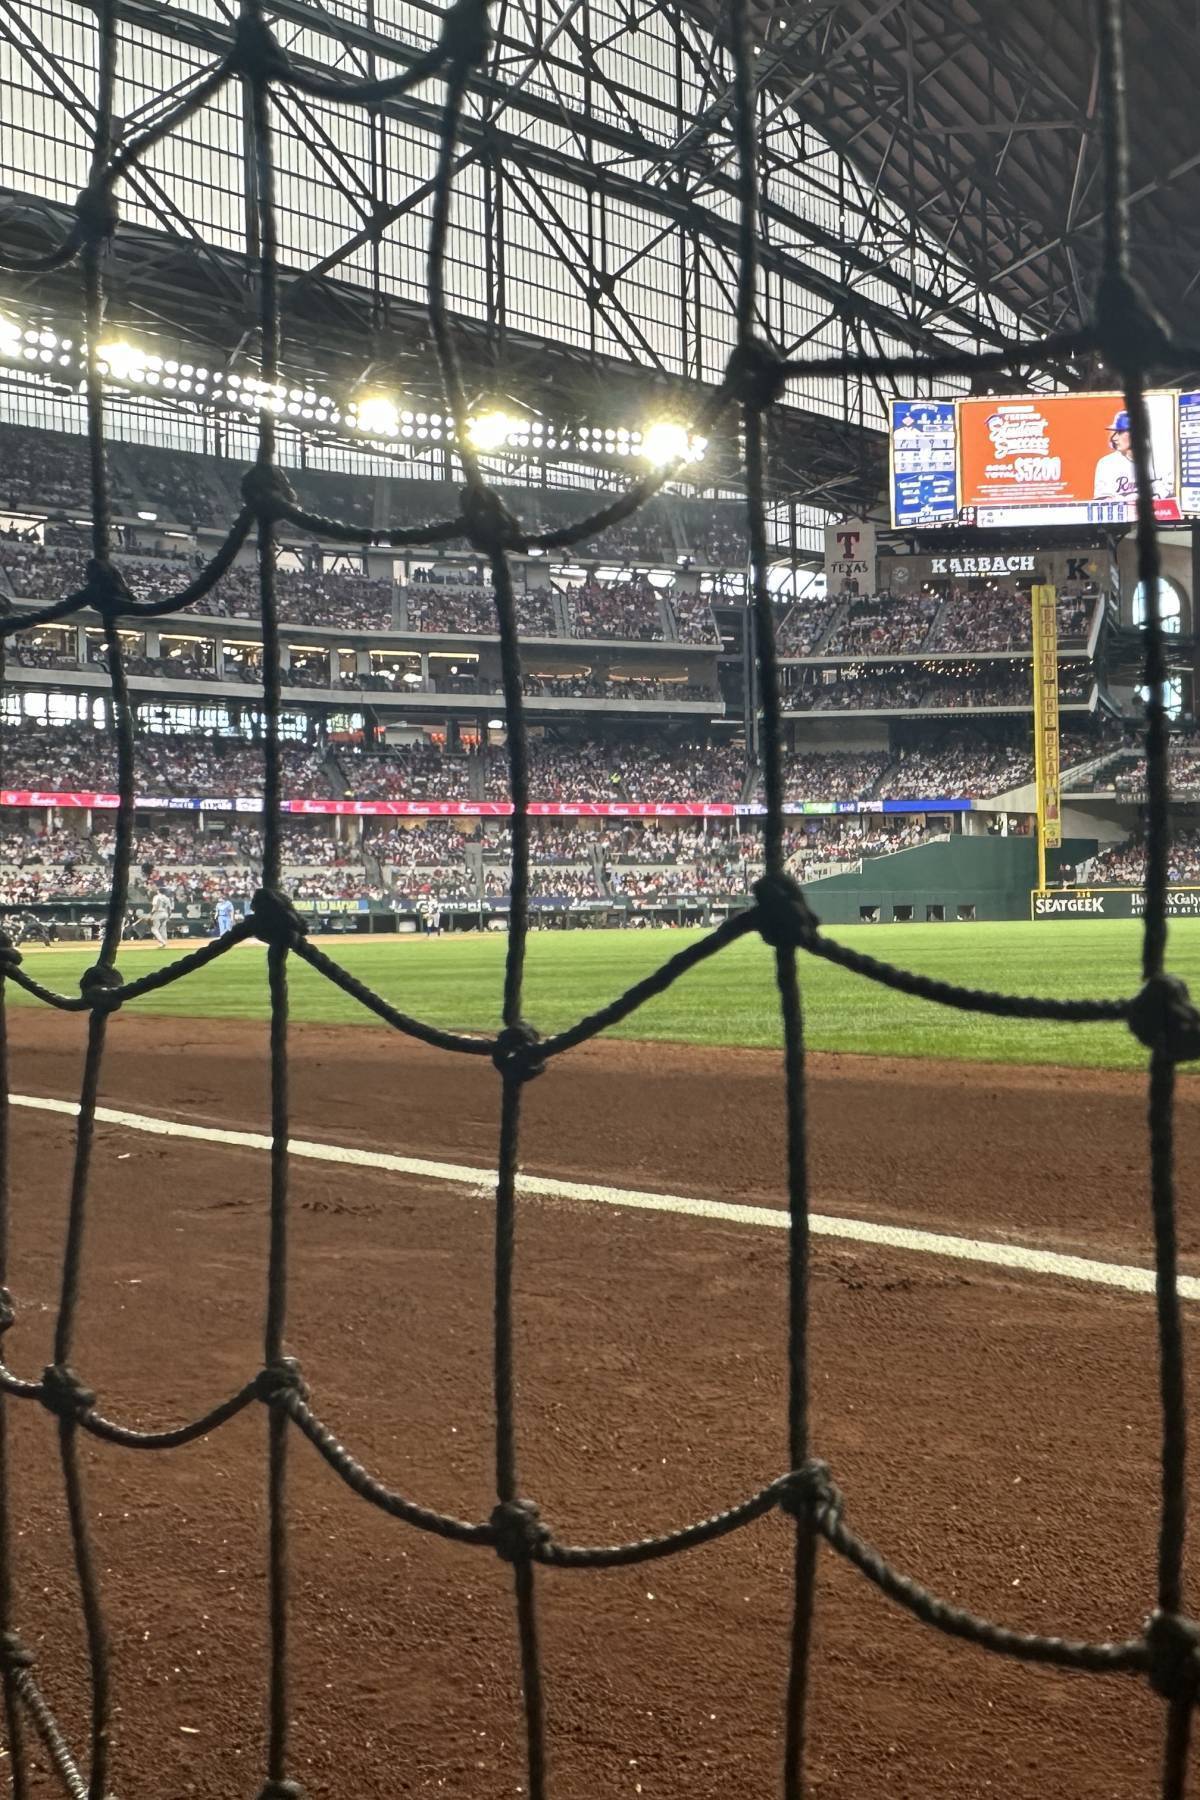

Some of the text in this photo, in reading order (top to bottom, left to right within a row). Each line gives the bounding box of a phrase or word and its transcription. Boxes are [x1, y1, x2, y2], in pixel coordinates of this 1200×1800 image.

[837, 532, 860, 559] T
[831, 563, 868, 574] TEXAS
[931, 556, 1035, 573] KARBACH
[1066, 558, 1090, 580] K
[1036, 897, 1104, 913] SEATGEEK
